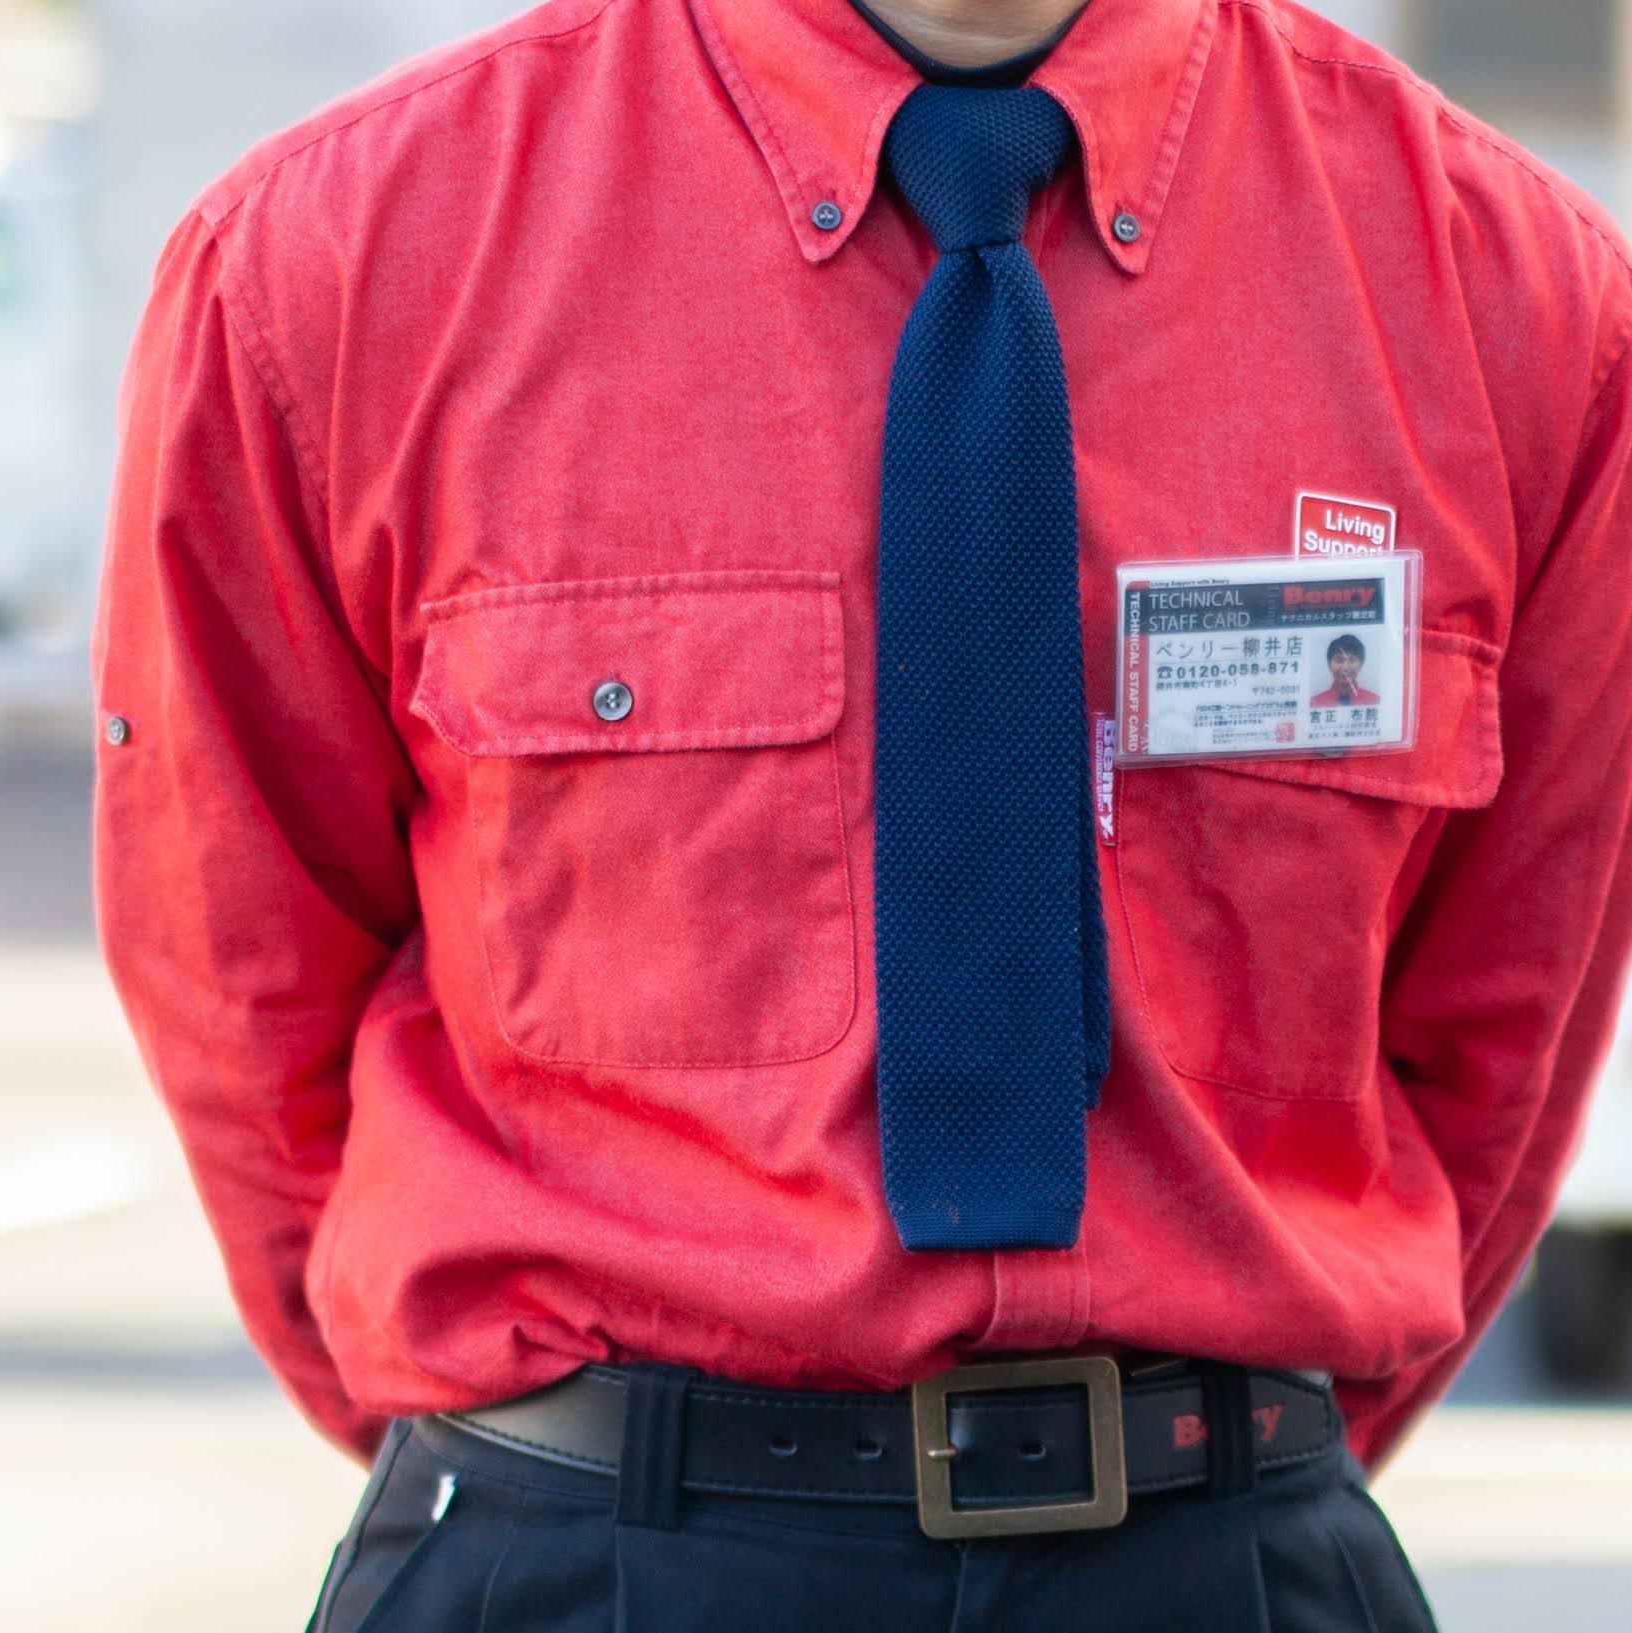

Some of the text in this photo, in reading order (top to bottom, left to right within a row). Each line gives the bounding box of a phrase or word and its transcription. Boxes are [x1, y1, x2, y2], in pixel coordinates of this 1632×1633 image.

[1324, 509, 1385, 545] Living
[1149, 589, 1244, 610] TECHNICAL
[1281, 584, 1376, 608] Benry
[1149, 612, 1251, 632] STAFF CARD
[1156, 635, 1304, 659] ベンリー柳井店
[1128, 591, 1141, 752] TECHNICAL STAFF CARD
[1099, 719, 1116, 839] Benry
